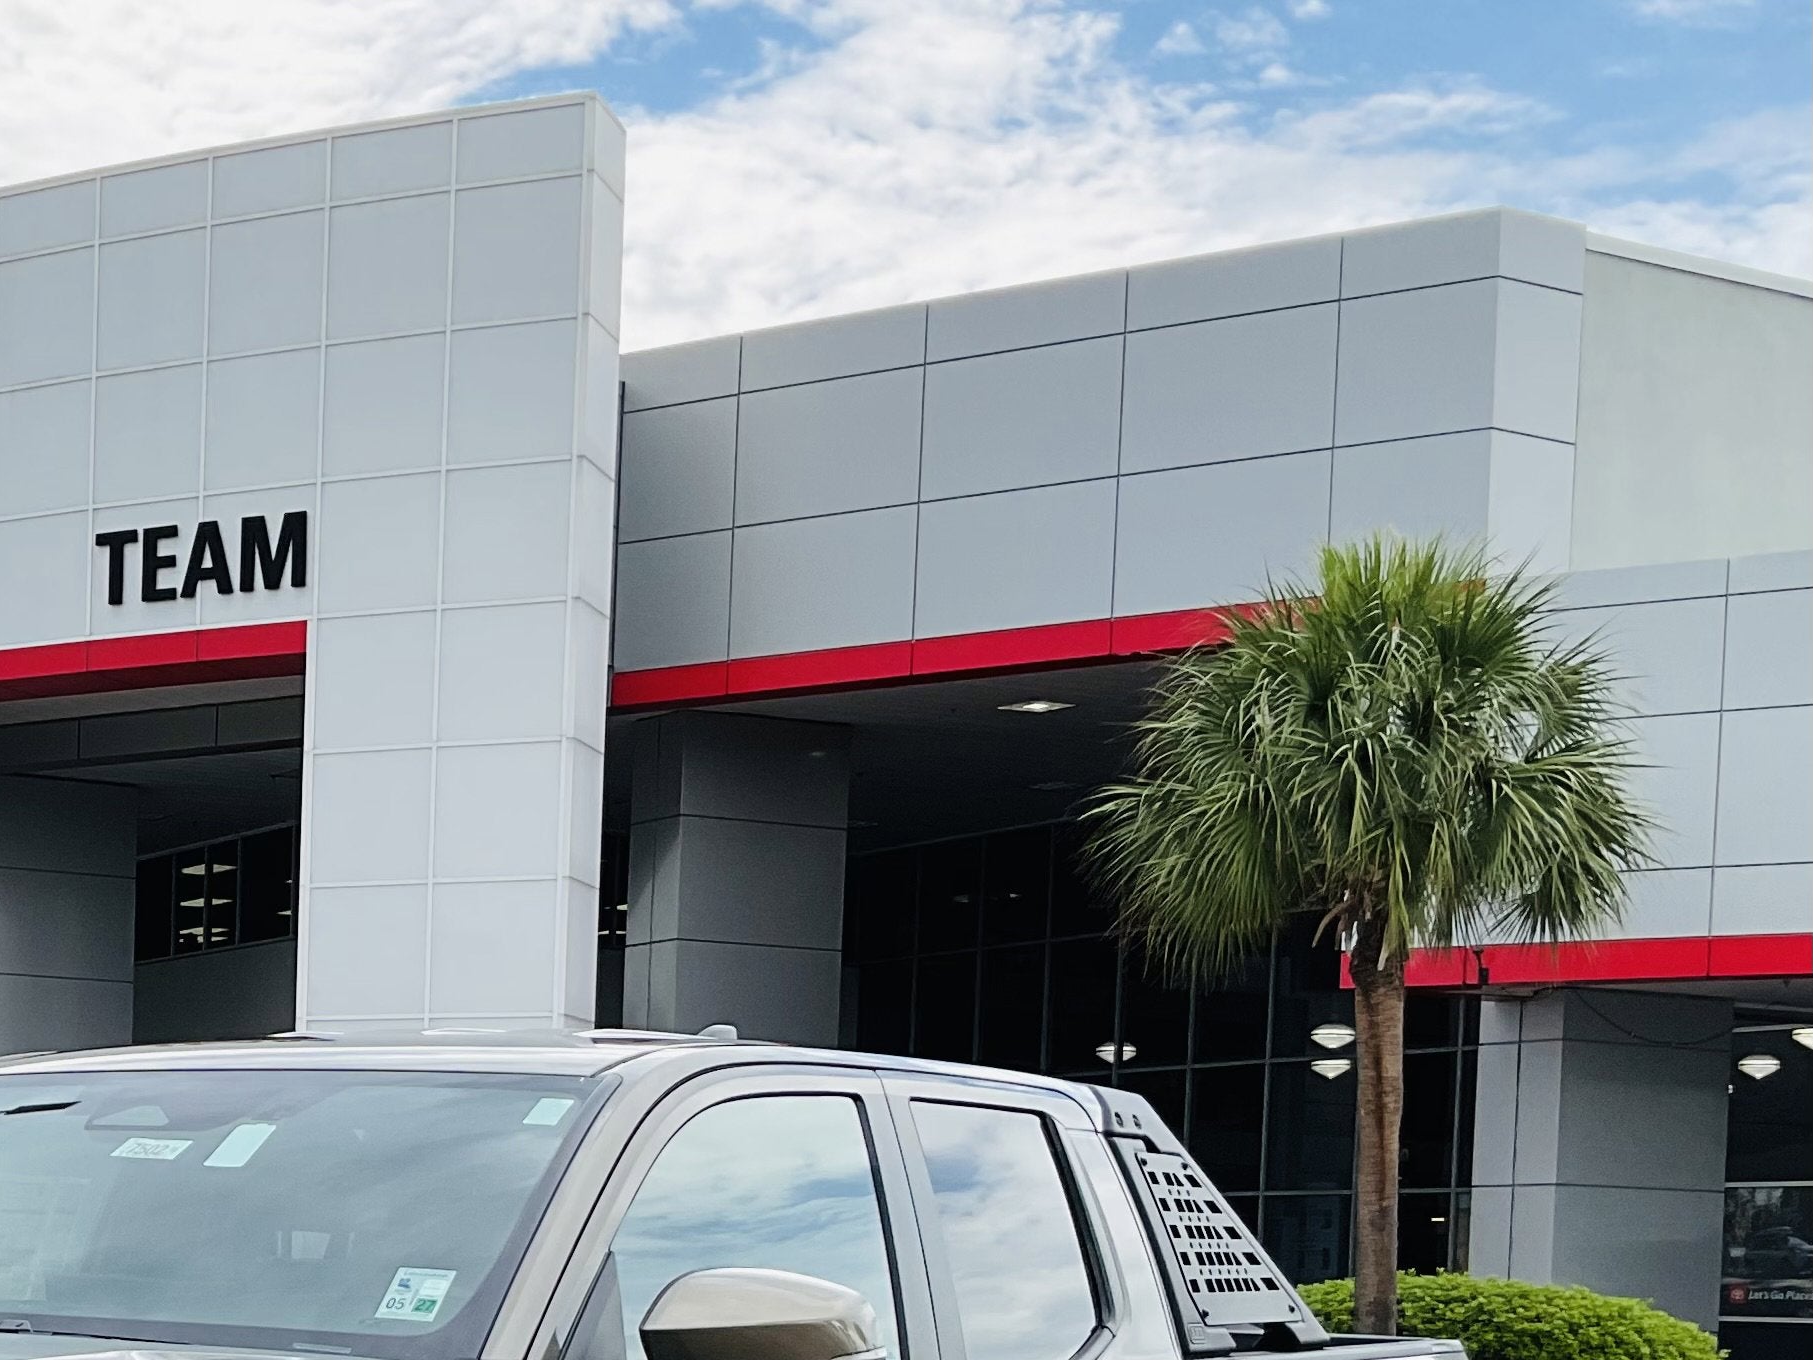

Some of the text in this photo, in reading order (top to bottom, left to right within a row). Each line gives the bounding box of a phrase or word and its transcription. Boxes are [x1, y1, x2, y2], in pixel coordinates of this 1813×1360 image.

[95, 511, 308, 605] TEAM
[385, 1297, 438, 1312] 05 27
